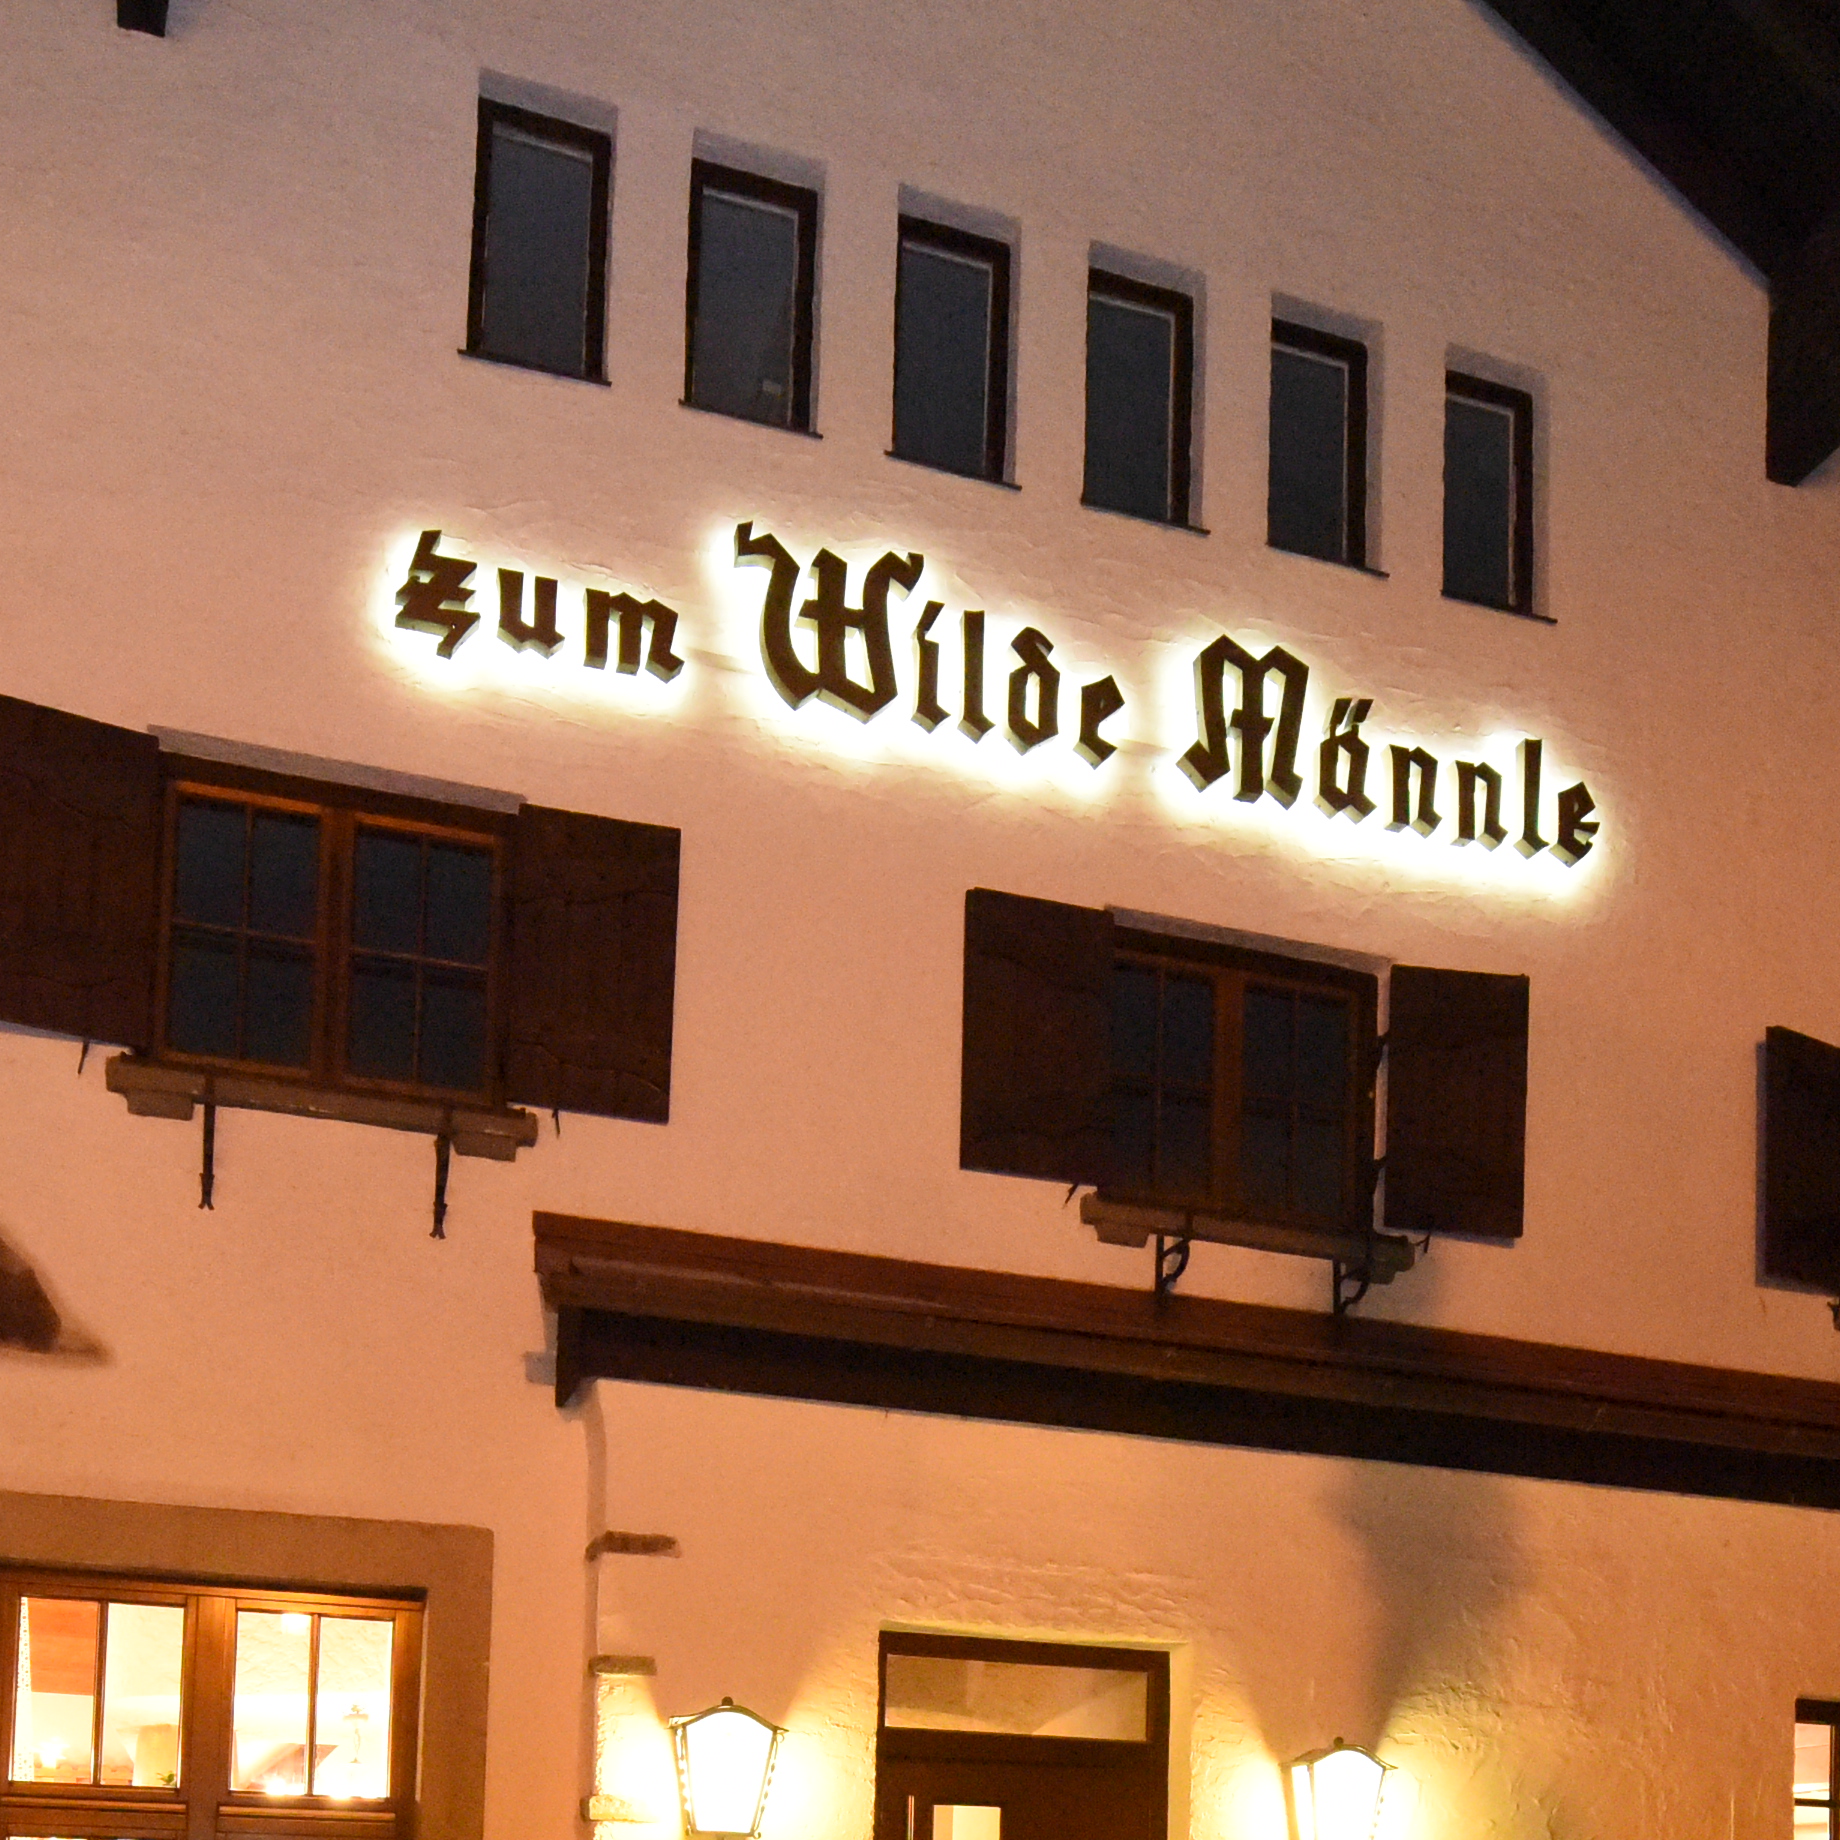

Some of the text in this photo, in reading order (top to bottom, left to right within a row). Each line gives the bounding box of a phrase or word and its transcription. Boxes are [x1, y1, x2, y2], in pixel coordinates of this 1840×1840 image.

[394, 520, 1600, 868] zum Wilde Männle
